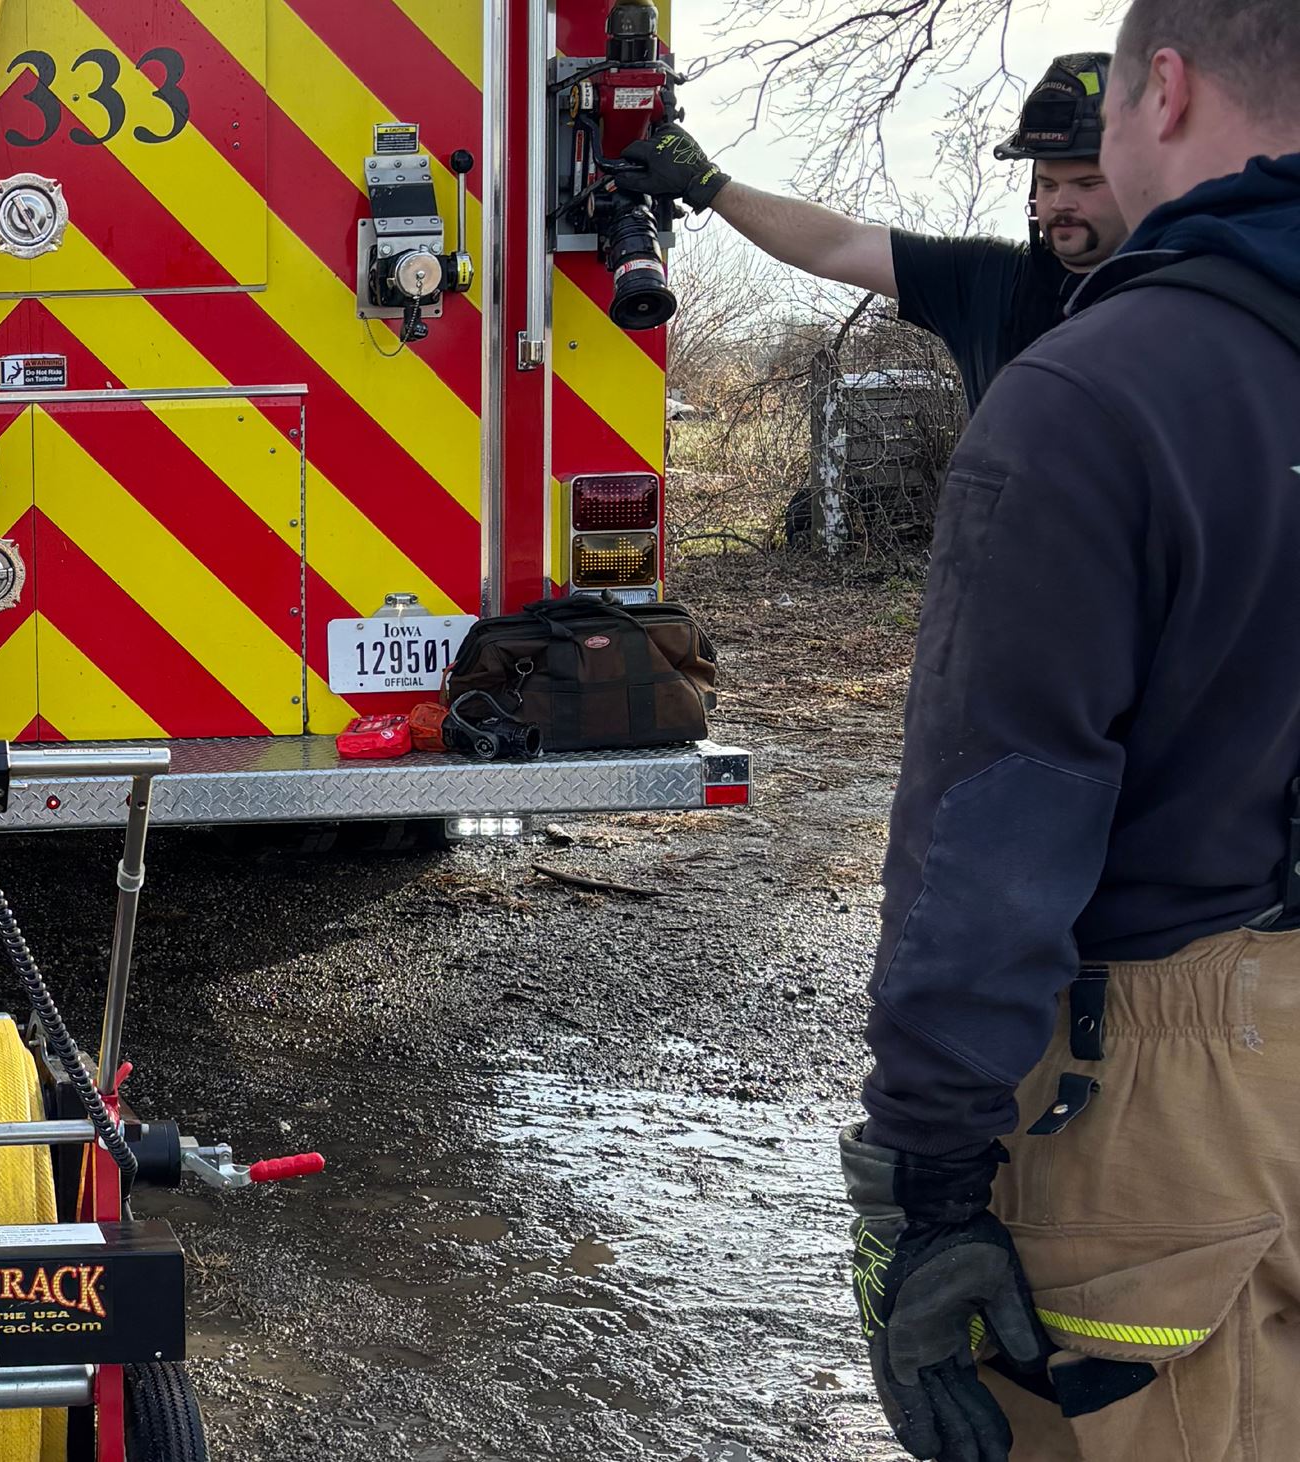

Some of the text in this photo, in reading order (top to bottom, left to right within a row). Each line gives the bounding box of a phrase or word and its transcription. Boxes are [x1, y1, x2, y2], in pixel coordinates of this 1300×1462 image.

[356, 639, 451, 675] 129501
[384, 677, 424, 687] OFFICIAL
[34, 1309, 71, 1319] USA
